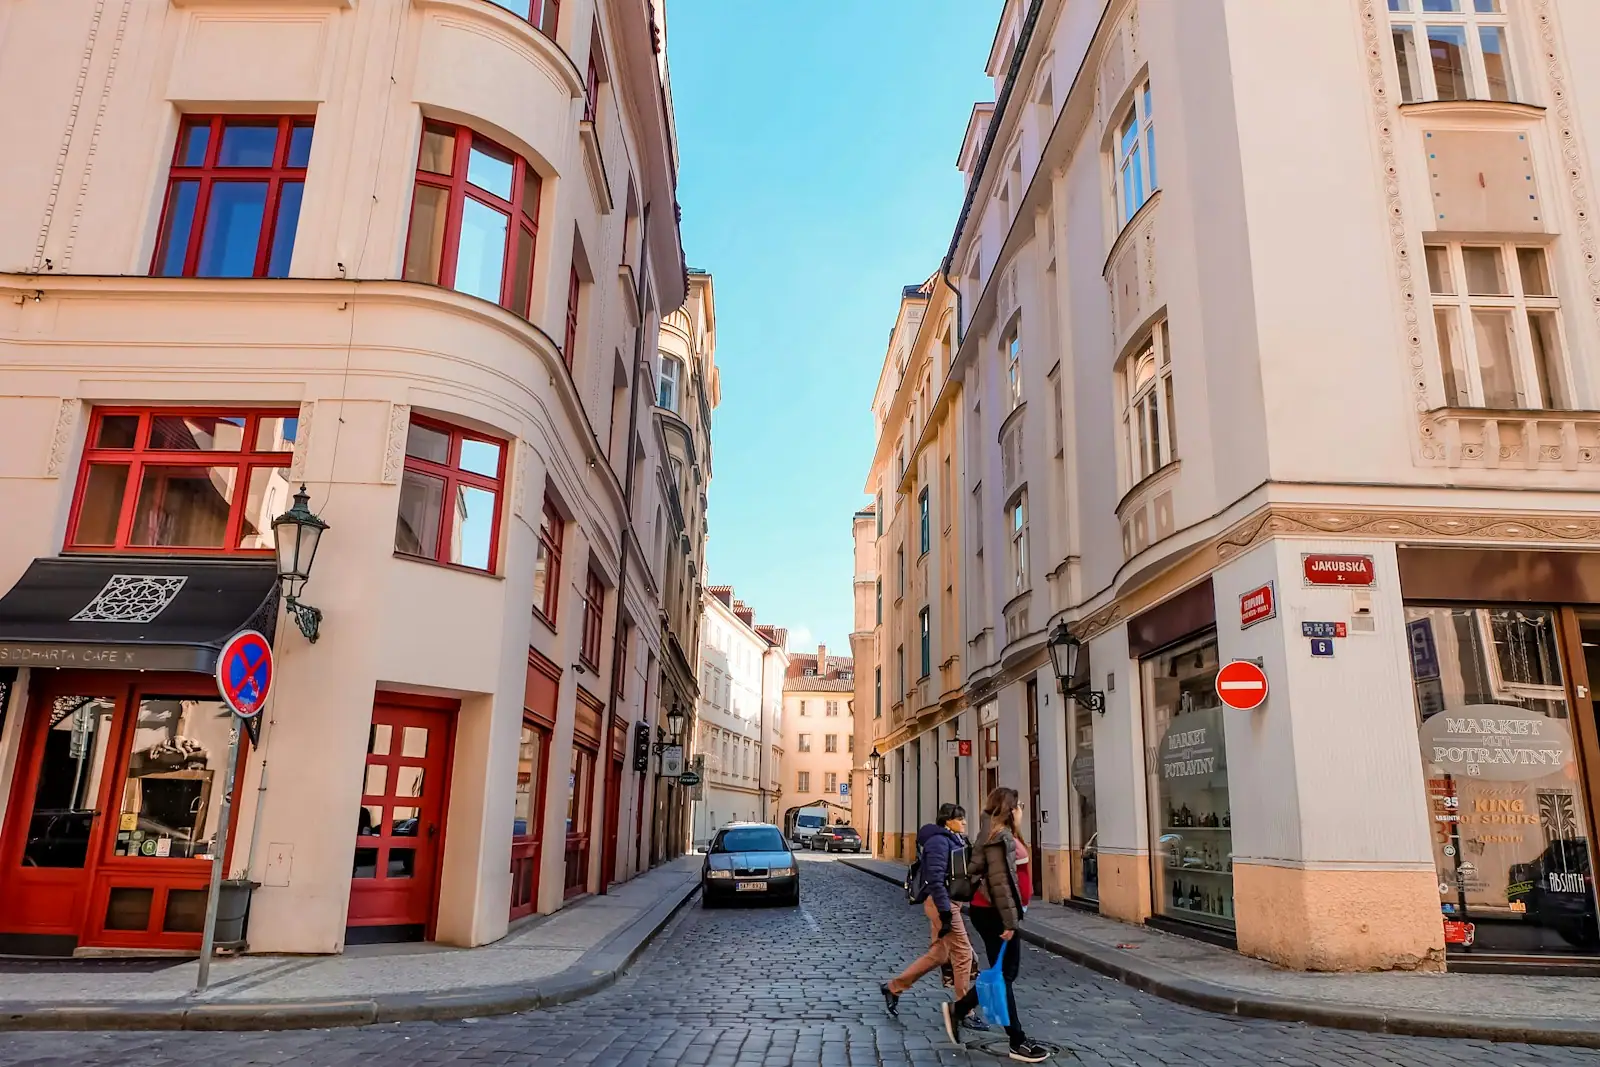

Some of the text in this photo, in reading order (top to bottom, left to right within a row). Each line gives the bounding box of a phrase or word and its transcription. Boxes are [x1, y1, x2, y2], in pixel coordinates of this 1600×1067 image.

[1311, 560, 1367, 572] JAKUBSKÁ
[0, 648, 76, 661] SIDDHARTA
[1319, 642, 1326, 653] 6
[1445, 717, 1543, 735] MARKET
[1168, 728, 1206, 750] MARKET
[1433, 747, 1563, 765] POTRAVINY
[1164, 757, 1215, 778] POTRAVINY
[1443, 796, 1459, 807] 35
[1474, 799, 1524, 813] KING
[1482, 814, 1540, 824] SPIRITS
[1549, 871, 1586, 893] ABSINTH
